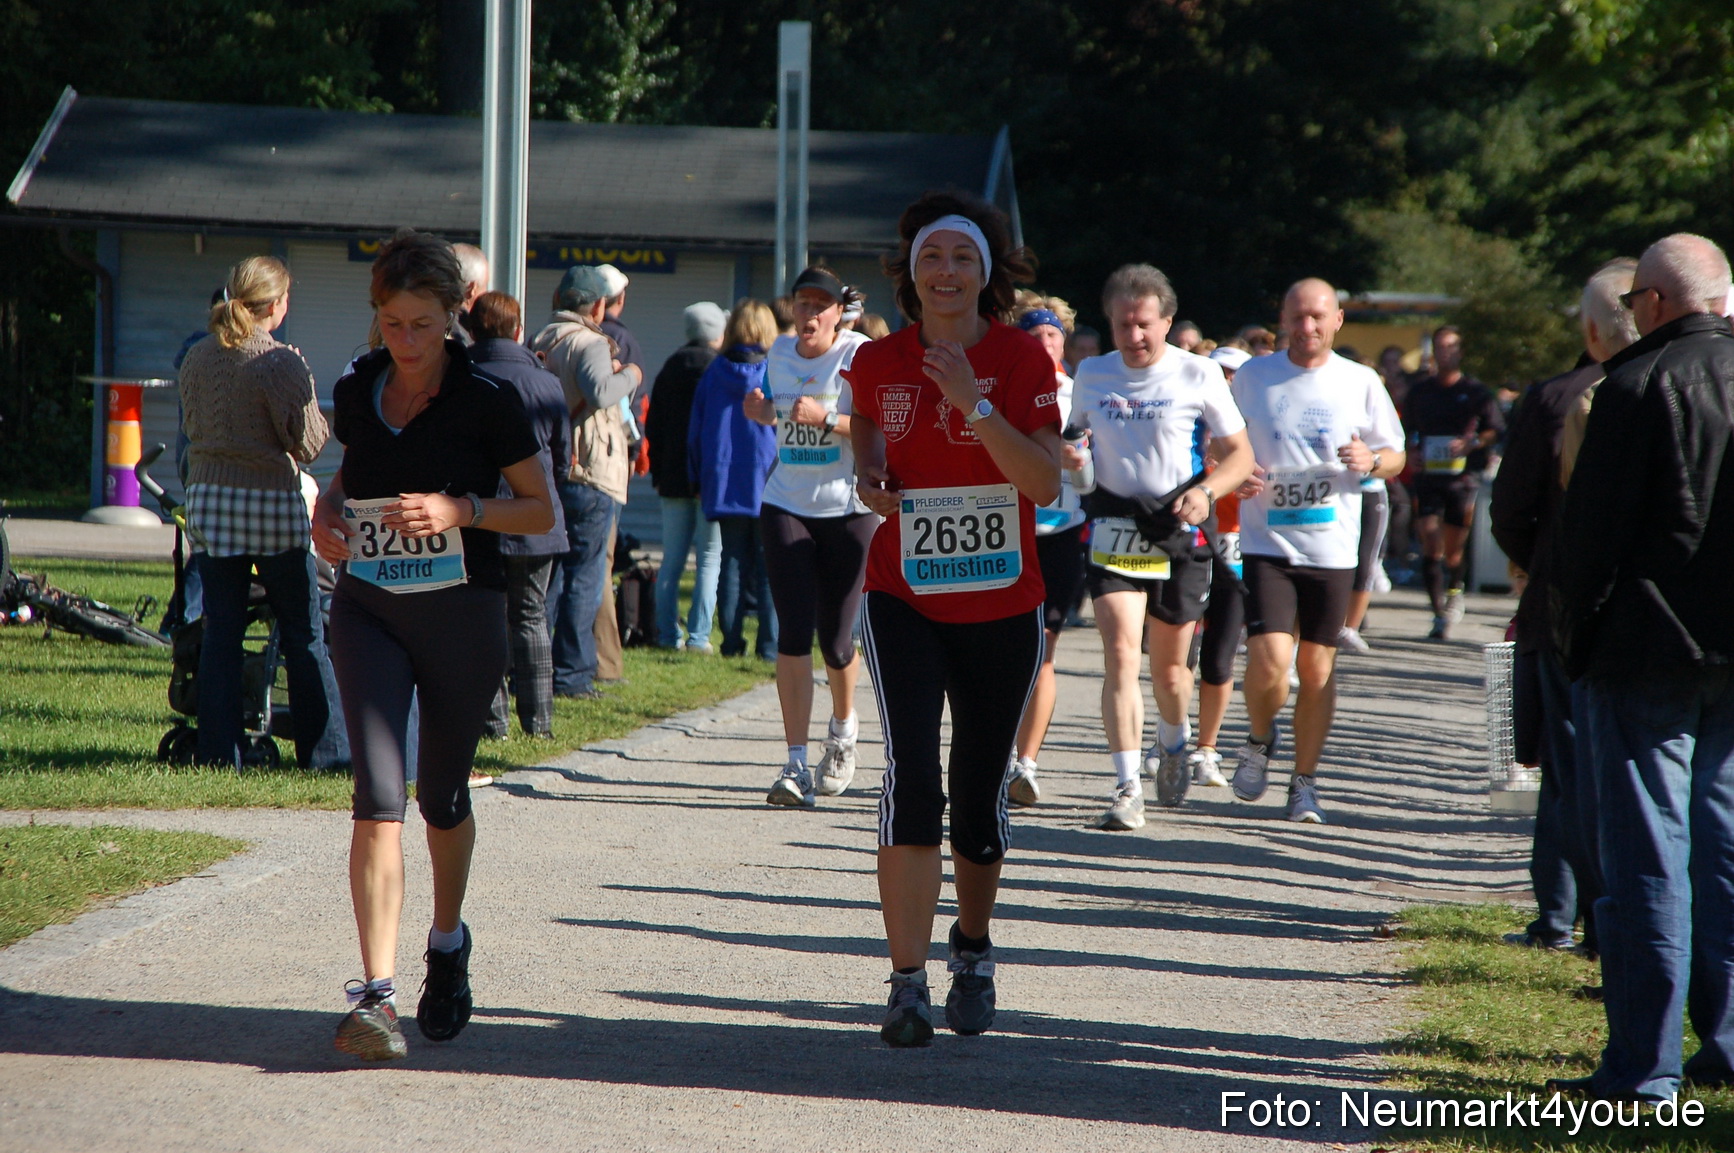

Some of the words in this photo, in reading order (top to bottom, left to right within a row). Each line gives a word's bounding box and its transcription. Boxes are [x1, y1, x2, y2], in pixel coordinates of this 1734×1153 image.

[883, 393, 911, 401] IMMER
[882, 402, 911, 410] WIEDER
[883, 411, 908, 423] NEU
[883, 424, 906, 432] MARKT
[790, 448, 827, 461] Sabina
[1273, 481, 1332, 507] 3542
[915, 496, 964, 507] PFLEIDERER
[913, 513, 1006, 556] 2638
[916, 556, 1007, 580] Christine
[1108, 554, 1153, 570] Gregor
[376, 559, 433, 581] Astrid
